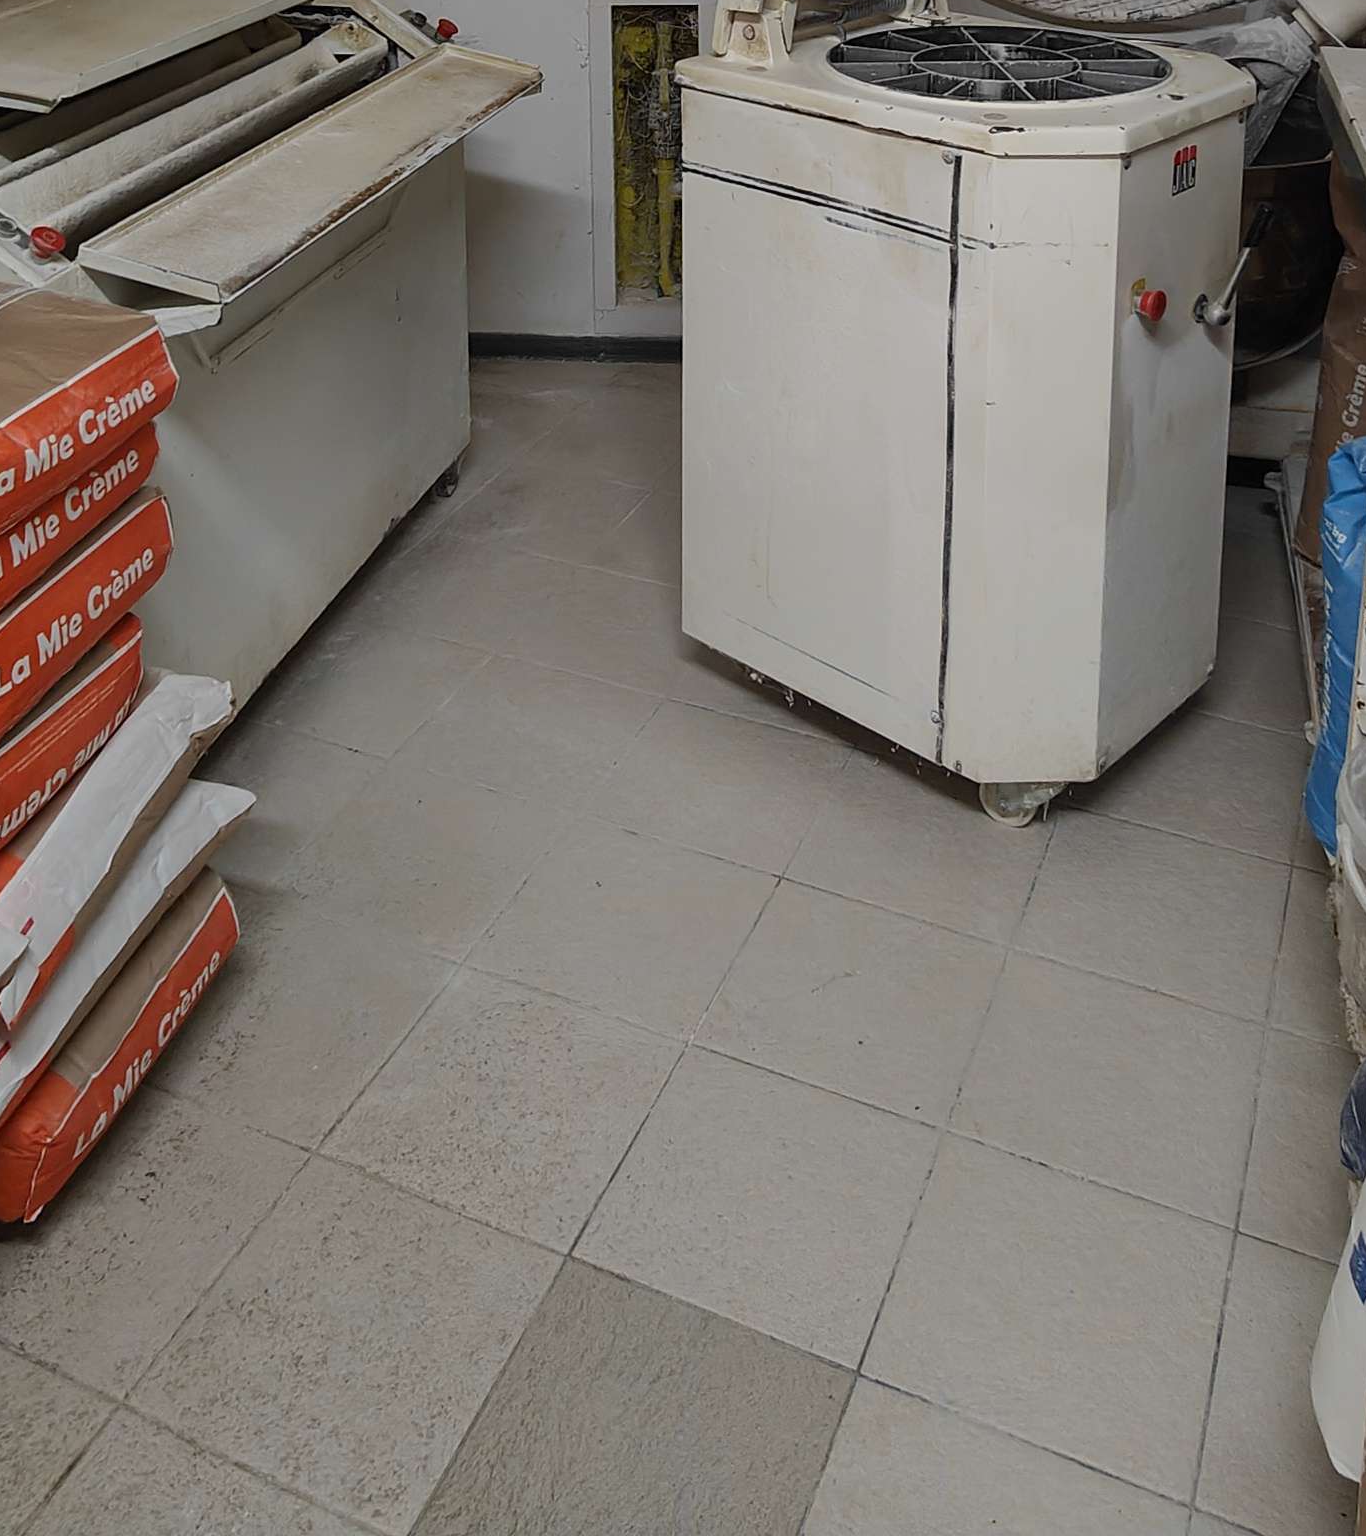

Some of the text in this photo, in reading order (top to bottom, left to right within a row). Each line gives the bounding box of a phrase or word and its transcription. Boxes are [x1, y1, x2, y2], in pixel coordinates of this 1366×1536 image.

[24, 434, 74, 482] Mie
[78, 379, 156, 445] Crème
[9, 513, 60, 568] Mie
[64, 449, 139, 521] Crème
[36, 611, 83, 666] Mie
[87, 547, 154, 619] Crème
[72, 951, 220, 1159] La Mie Crème
